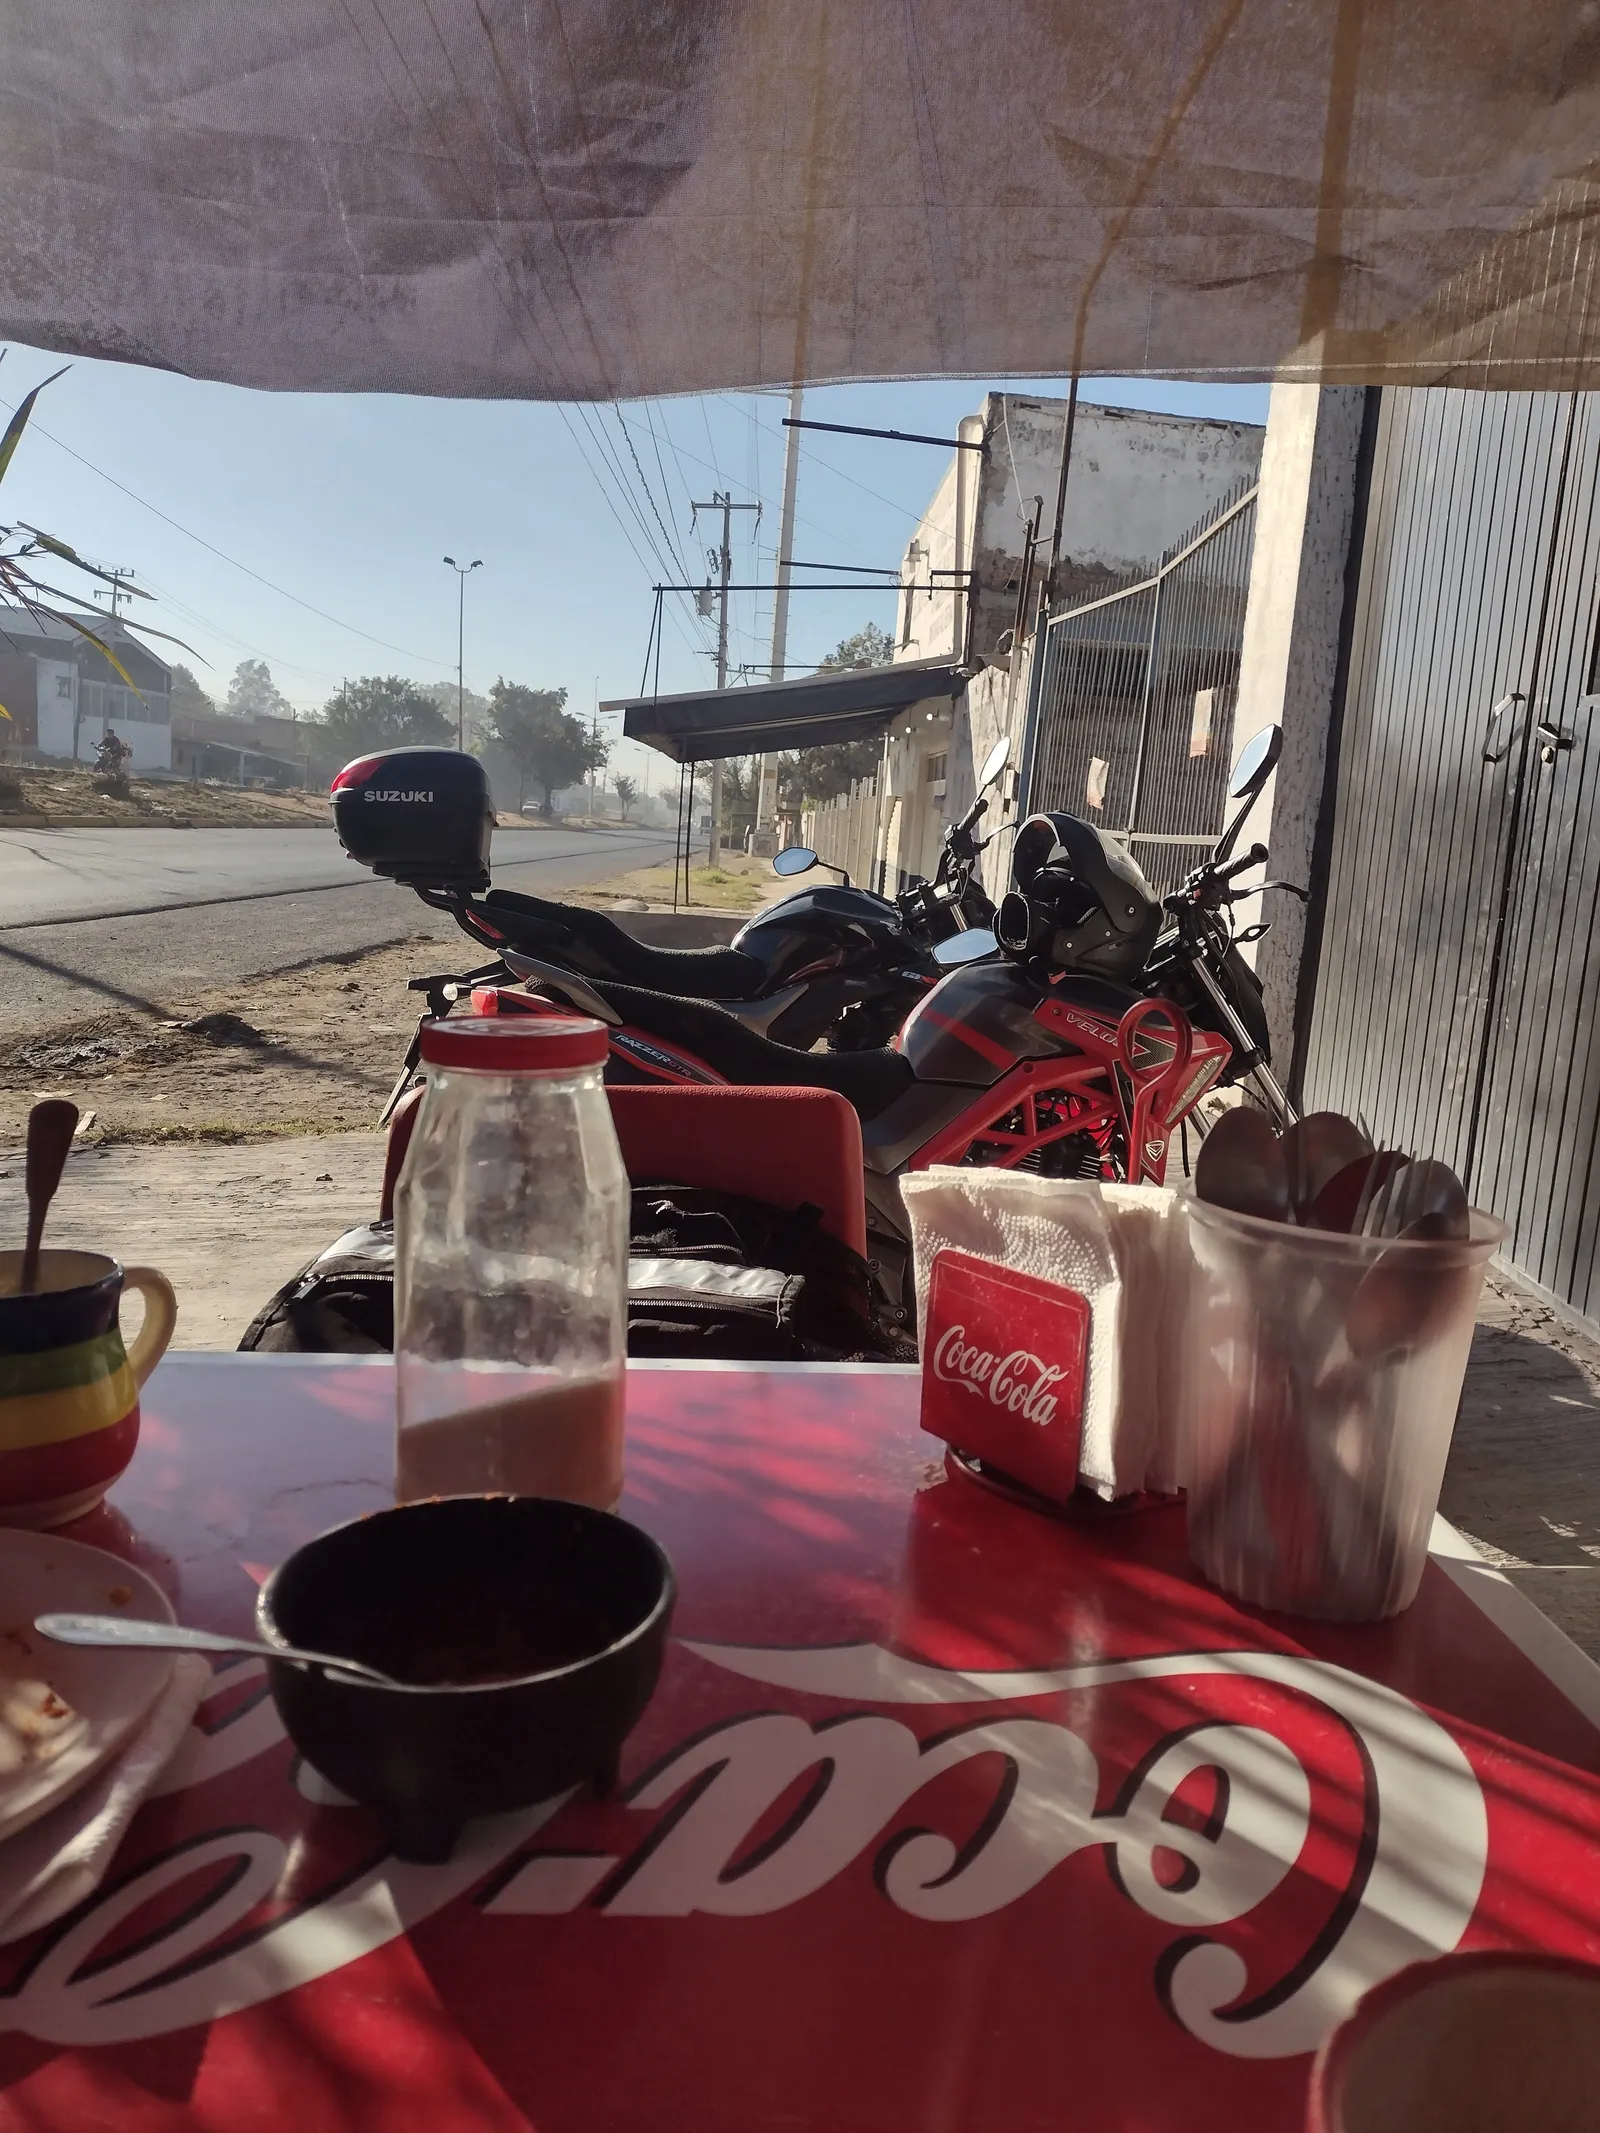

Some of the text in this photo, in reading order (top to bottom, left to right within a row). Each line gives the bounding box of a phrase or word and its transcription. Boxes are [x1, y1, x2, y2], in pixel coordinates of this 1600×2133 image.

[363, 790, 434, 803] SUZUKI
[1066, 1012, 1119, 1048] VELO
[933, 1324, 1070, 1427] Coca-Cola
